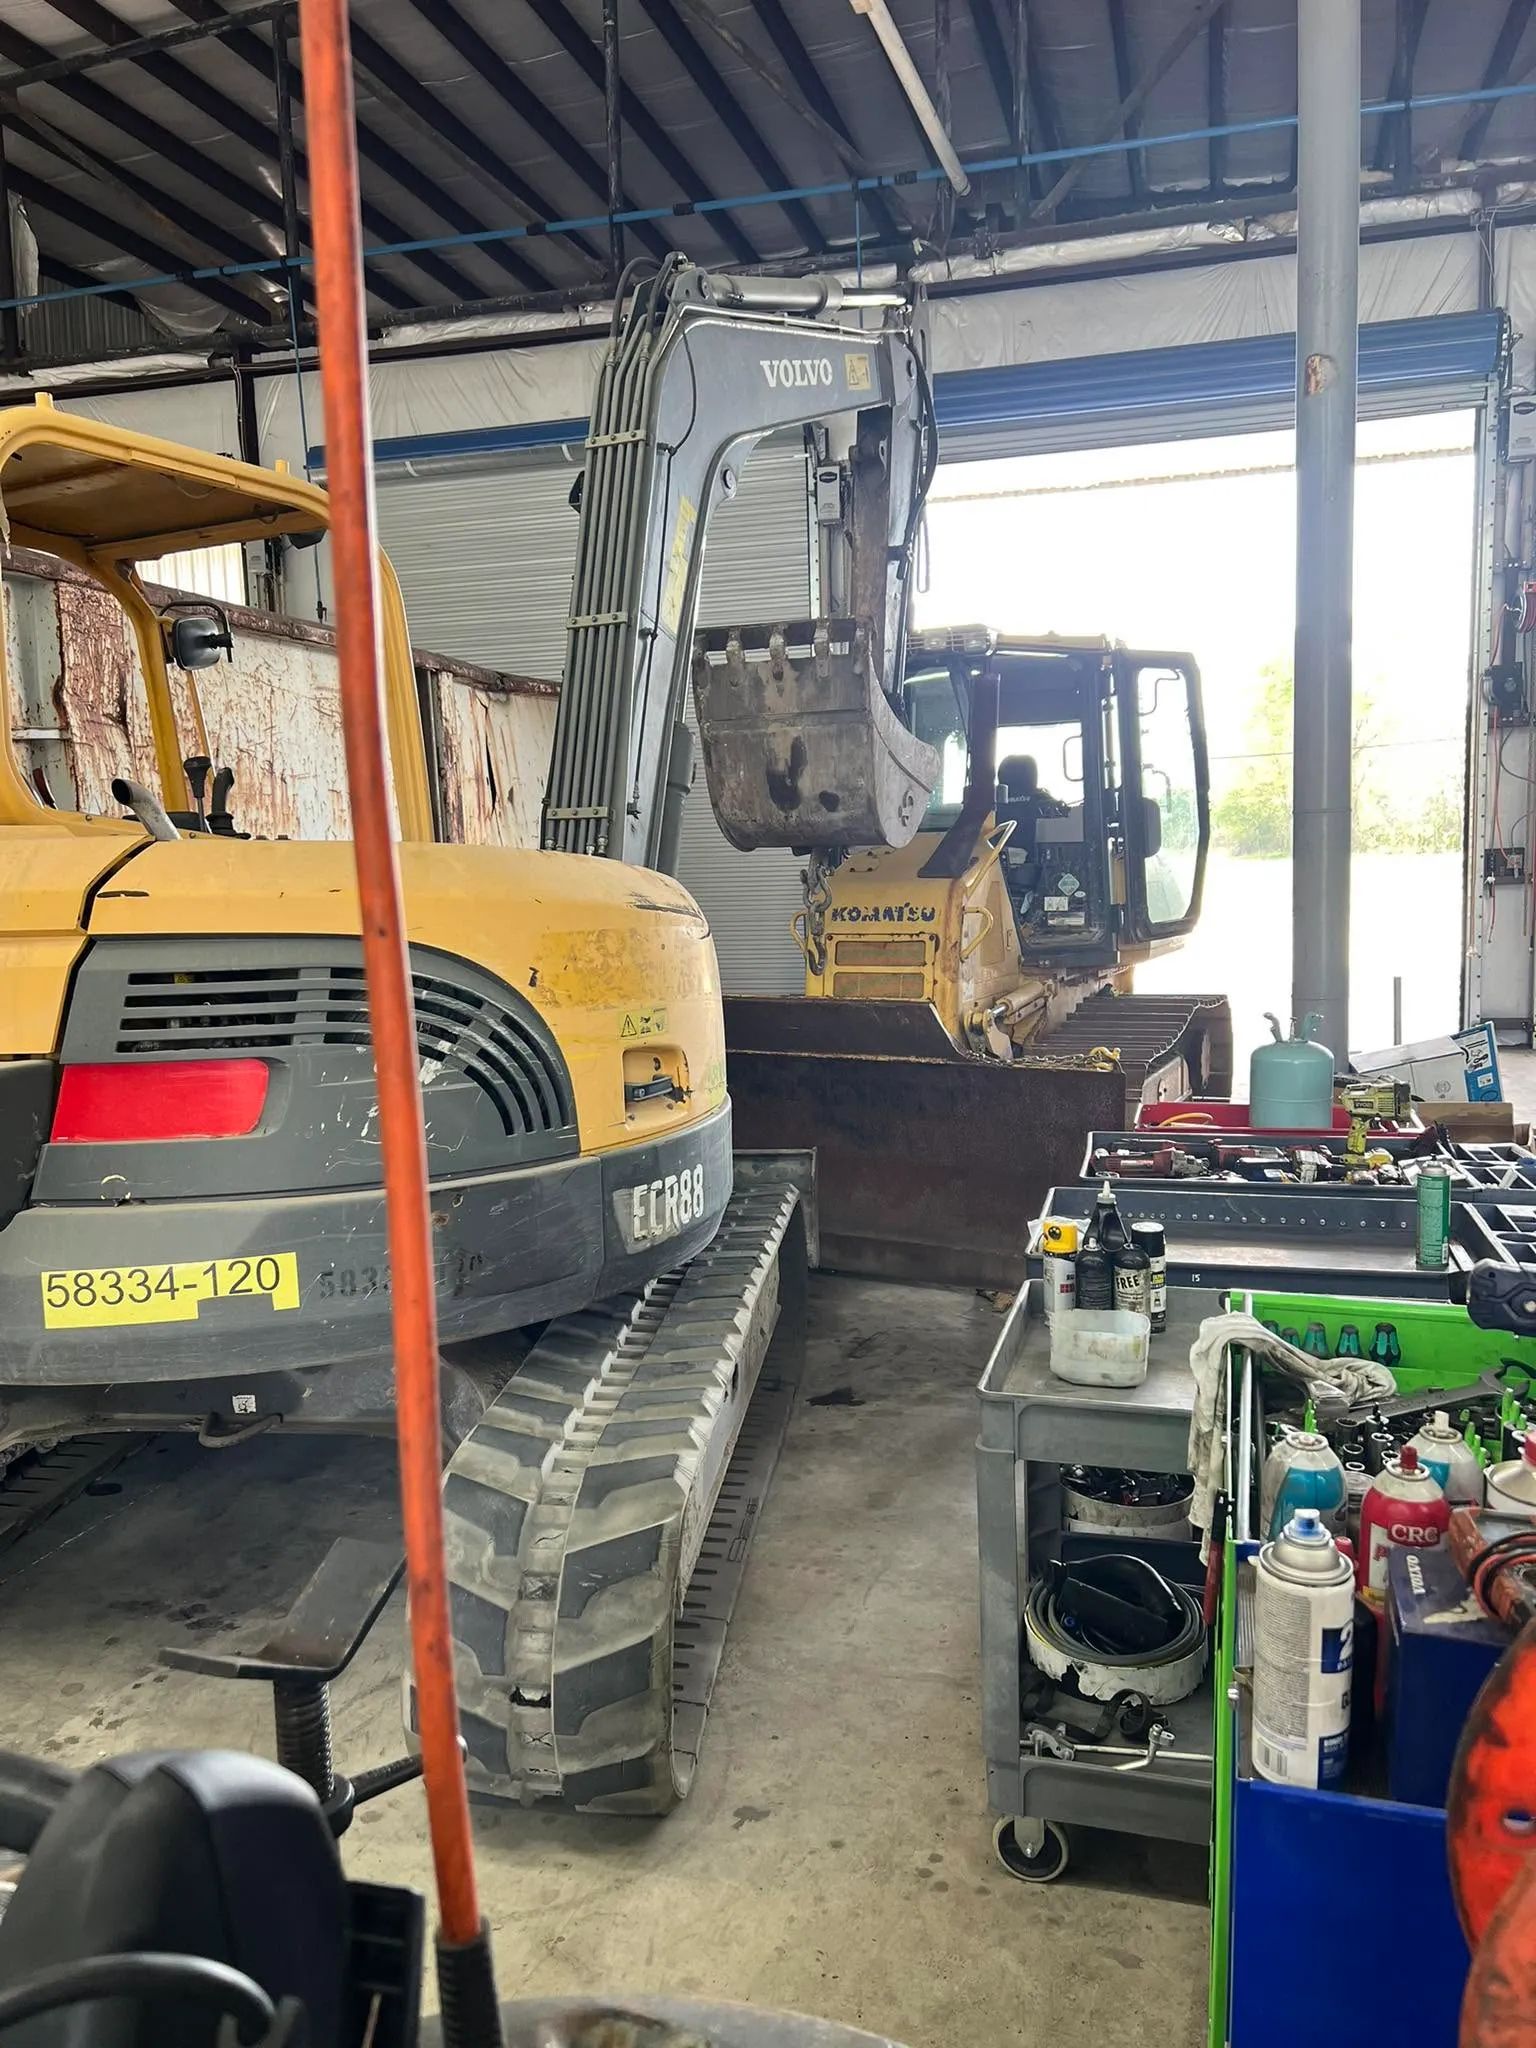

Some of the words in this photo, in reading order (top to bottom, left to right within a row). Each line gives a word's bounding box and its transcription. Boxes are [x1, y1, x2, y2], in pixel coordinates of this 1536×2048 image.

[760, 358, 833, 388] VOLVO
[832, 902, 936, 922] KOMATSU
[633, 1163, 704, 1240] ECR88
[47, 1257, 280, 1308] 58334-120
[1115, 1275, 1140, 1289] FREE
[1191, 1273, 1201, 1282] 15
[1391, 1523, 1438, 1543] CRC
[1406, 1554, 1426, 1595] VOLVO
